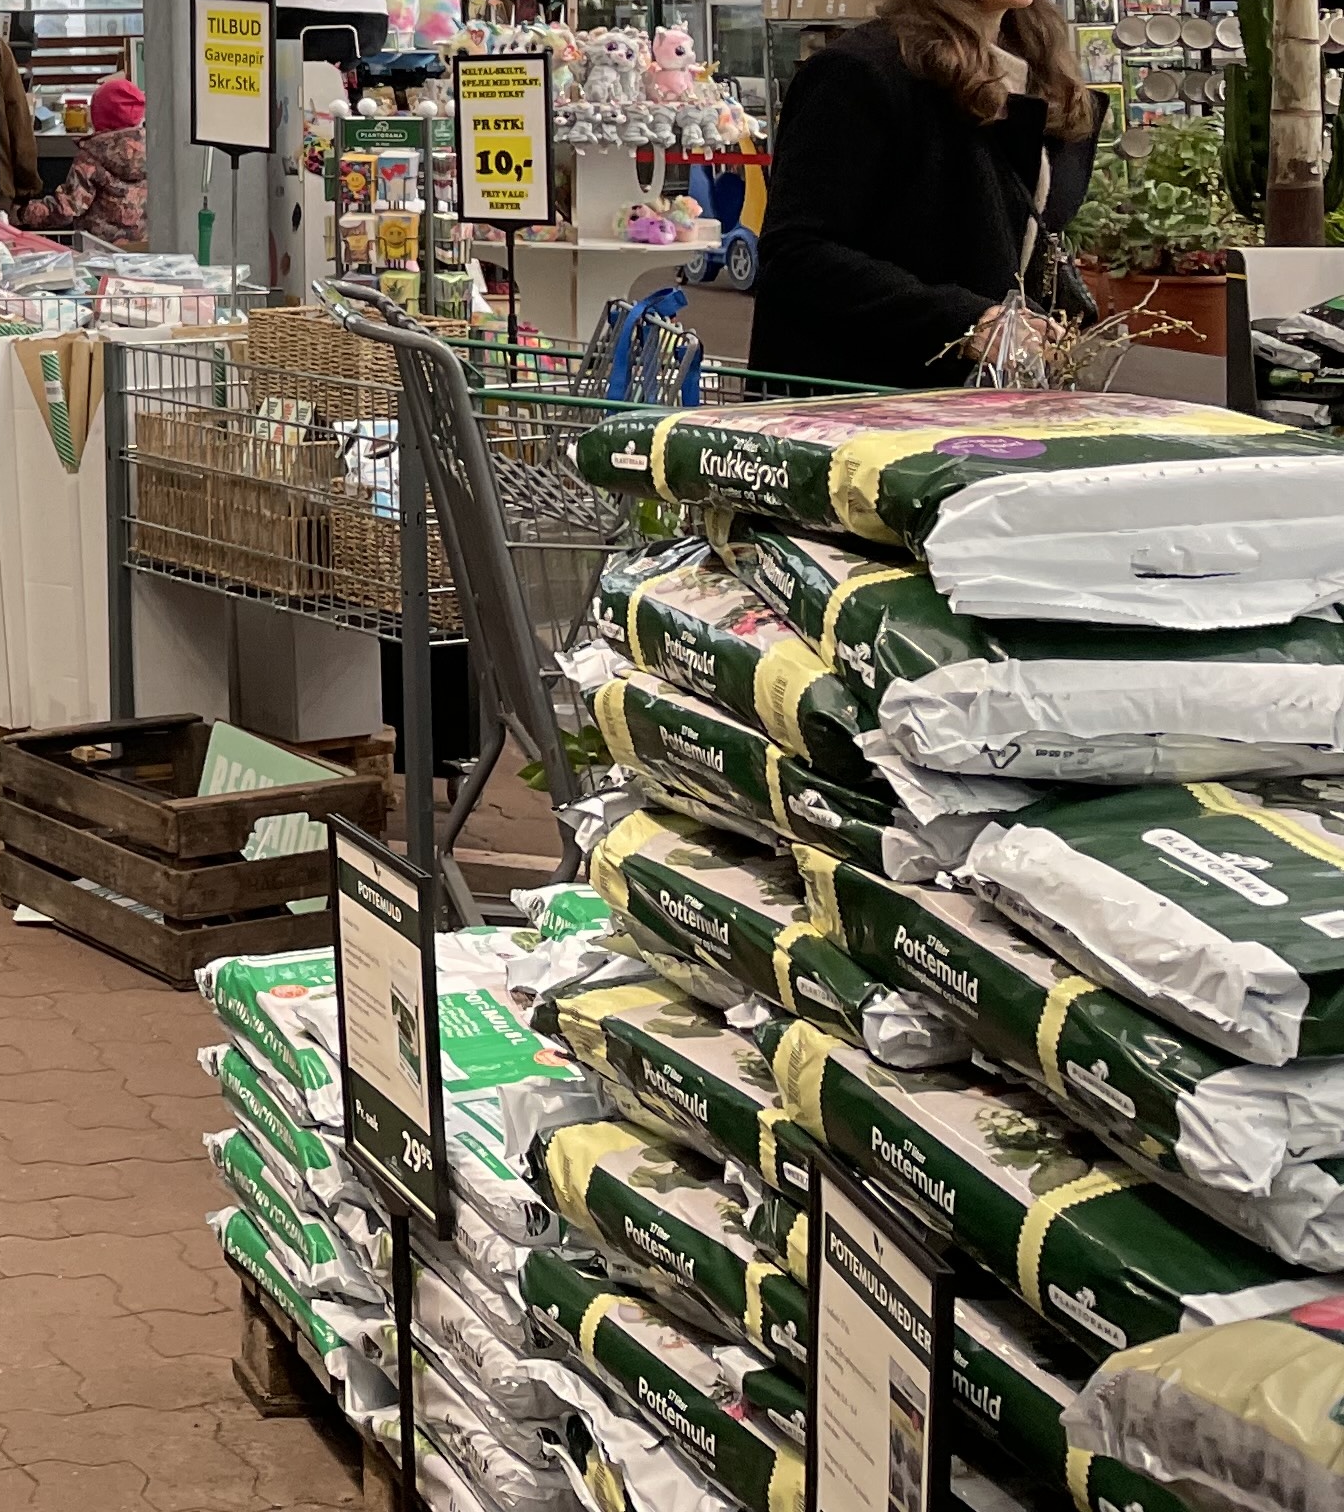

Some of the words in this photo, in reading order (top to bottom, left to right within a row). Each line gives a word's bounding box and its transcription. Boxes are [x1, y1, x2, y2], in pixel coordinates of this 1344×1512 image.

[207, 17, 261, 36] TILBUD
[205, 48, 264, 68] Gavepapir
[209, 73, 260, 92] 5kr.Stk.
[498, 90, 524, 98] TEKST
[473, 119, 491, 131] PR
[476, 150, 533, 182] 10,-
[700, 447, 789, 491] Krukkejord
[664, 631, 715, 677] Pottemuld
[659, 725, 724, 773] Pottemuld
[1159, 835, 1271, 898] PLANTORAMA
[357, 879, 403, 924] POTTEMULD
[659, 890, 729, 946] Pottemuld
[894, 924, 979, 1004] Pottemuld
[642, 1058, 708, 1122] Pottemuld
[903, 1138, 914, 1153] 17
[872, 1125, 956, 1216] Pottemuld
[624, 1215, 696, 1282] Pottemuld
[830, 1232, 889, 1310] POTTEMULD
[888, 1288, 911, 1332] MED
[638, 1376, 717, 1458] Pottemuld
